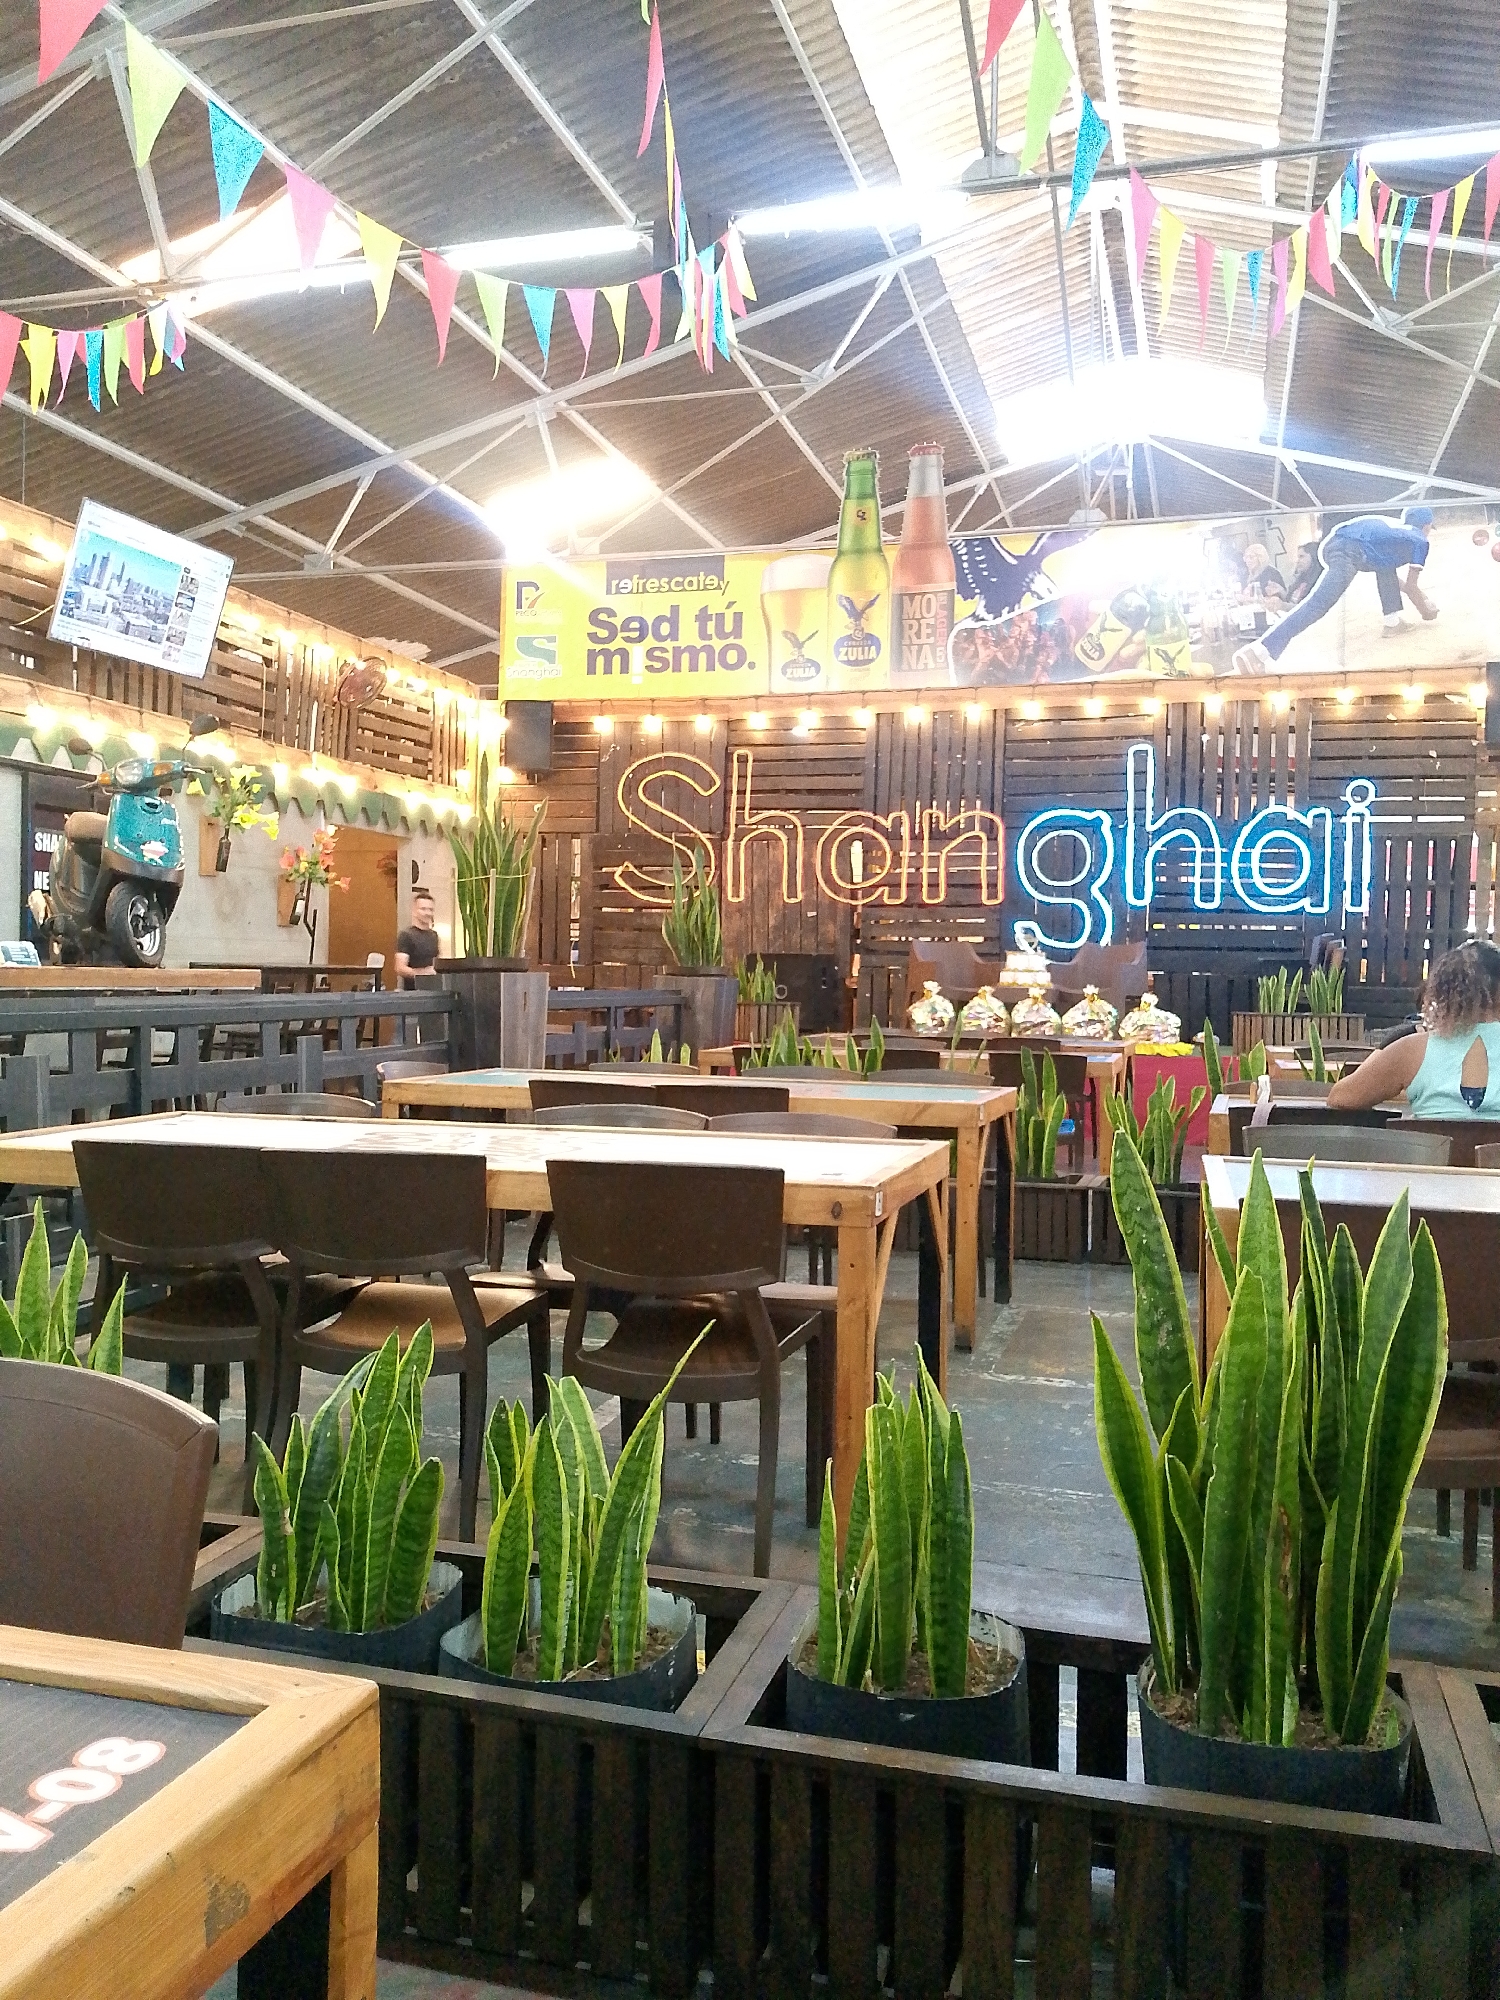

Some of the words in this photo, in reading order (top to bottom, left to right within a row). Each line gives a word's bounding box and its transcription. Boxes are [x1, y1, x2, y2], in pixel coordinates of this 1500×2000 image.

[901, 593, 937, 620] MO
[587, 604, 681, 645] Sed
[695, 601, 744, 642] tú
[901, 618, 936, 645] RE
[837, 645, 877, 661] ZULIA
[901, 644, 936, 670] NA
[786, 665, 817, 678] ZULIA
[34, 831, 63, 853] SHA
[613, 743, 1380, 952] Shanghai
